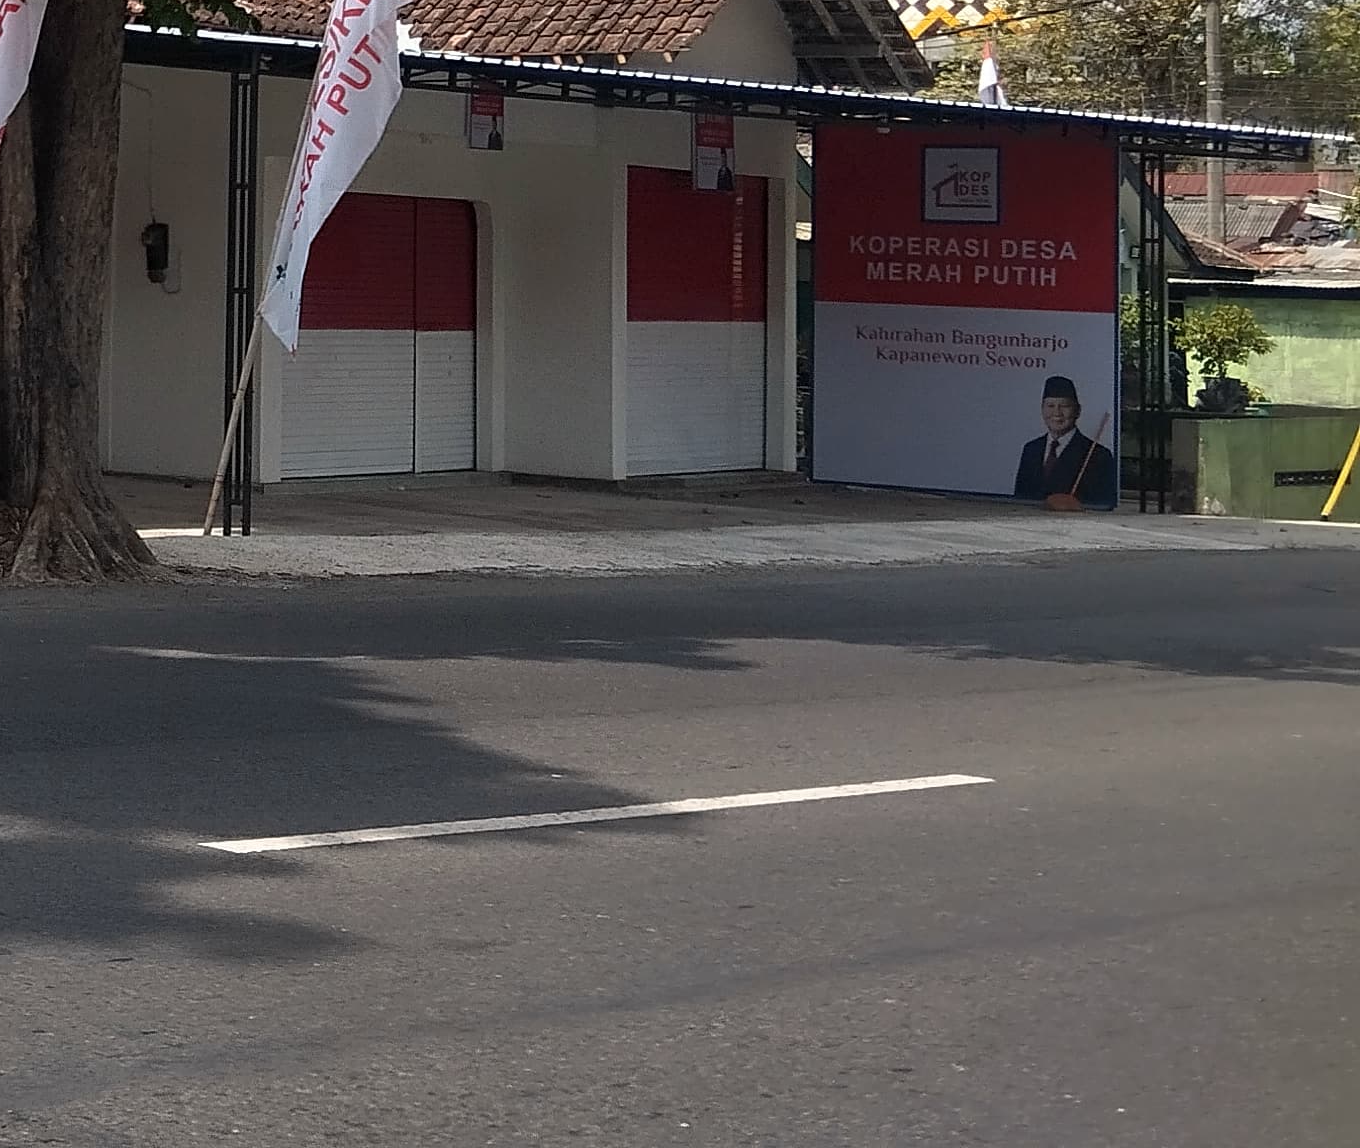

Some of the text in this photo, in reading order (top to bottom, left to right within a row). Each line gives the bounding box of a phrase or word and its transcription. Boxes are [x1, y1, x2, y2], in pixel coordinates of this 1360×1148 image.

[959, 170, 991, 183] KOP
[959, 184, 989, 196] DES
[850, 236, 1078, 260] KOPERASI DESA
[867, 261, 1057, 286] MERAH PUTIH
[856, 326, 1068, 351] Kalurahan Bangunharjo
[875, 346, 1046, 368] Kapanewon Sewon
